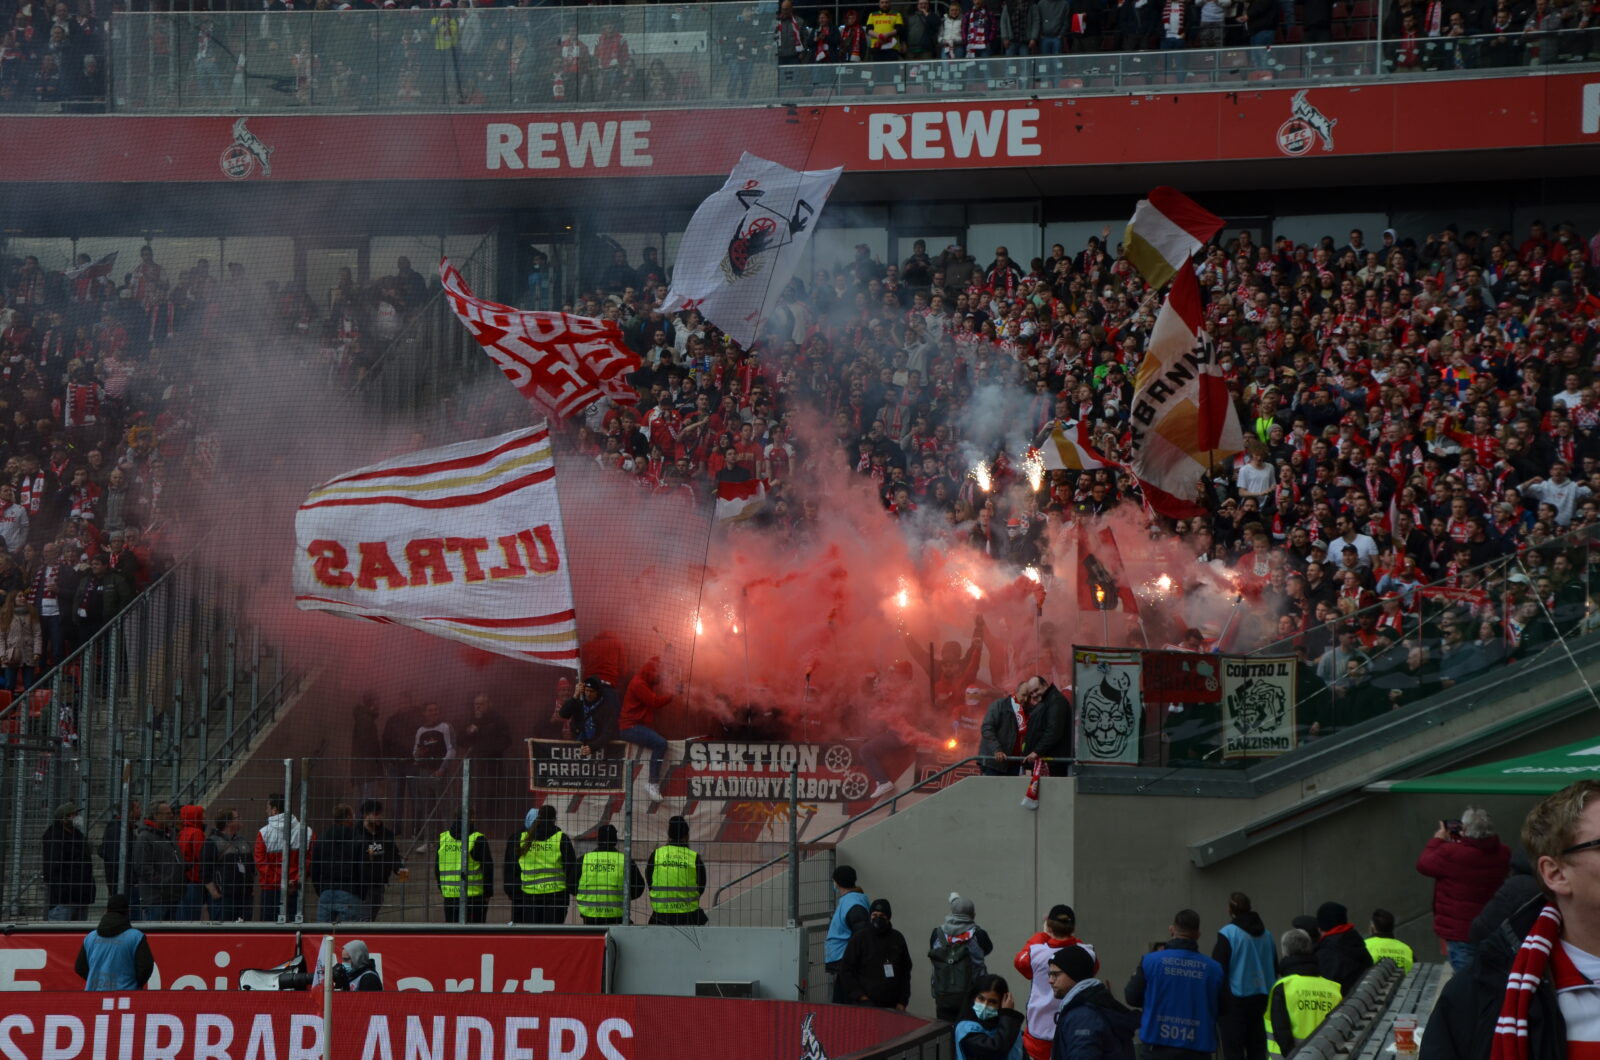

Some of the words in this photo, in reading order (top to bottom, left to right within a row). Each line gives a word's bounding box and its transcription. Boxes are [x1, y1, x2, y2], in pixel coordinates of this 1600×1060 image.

[869, 108, 1042, 160] REWE
[486, 120, 653, 169] REWE
[1226, 664, 1275, 677] CONTRO
[1276, 663, 1289, 676] IL
[1227, 737, 1289, 751] RAZZISMO
[690, 743, 819, 773] SEKTION
[538, 763, 618, 777] PARADISO
[691, 776, 842, 800] STADIONVERBOT
[590, 864, 616, 873] ORDNER
[662, 860, 688, 869] ORDNER
[1161, 957, 1208, 970] SECURITY
[1164, 966, 1205, 979] SERVICE
[1298, 1000, 1333, 1012] ORDNER
[360, 1013, 634, 1060] ANDERS
[1160, 1023, 1196, 1041] S014
